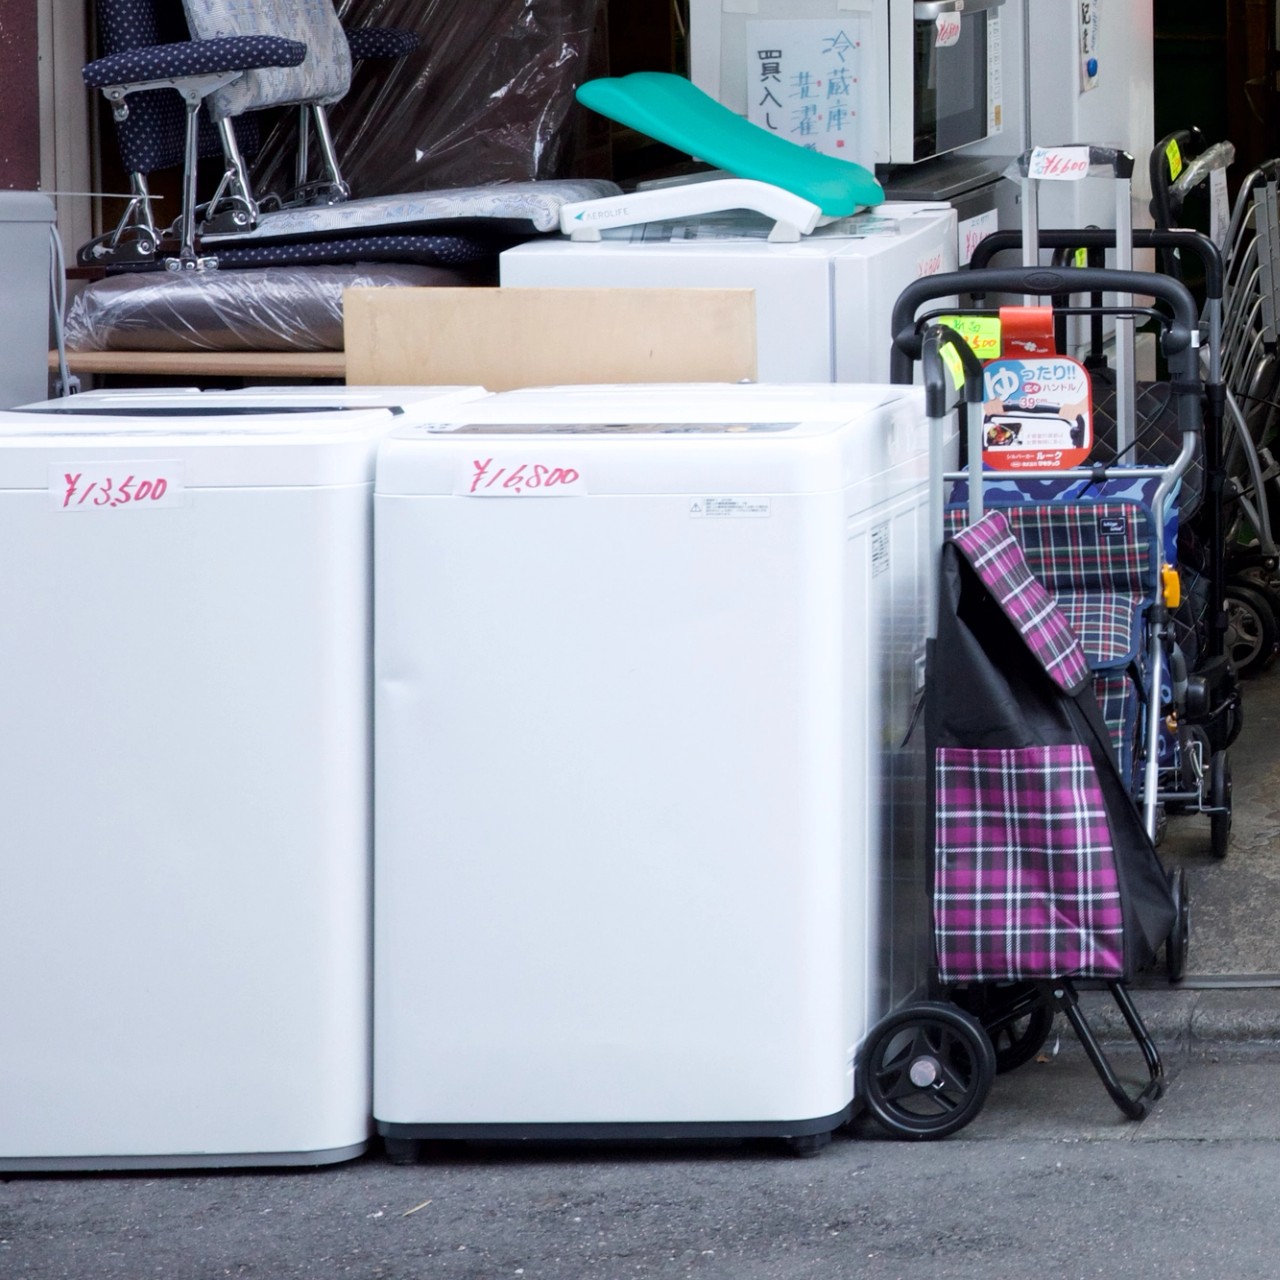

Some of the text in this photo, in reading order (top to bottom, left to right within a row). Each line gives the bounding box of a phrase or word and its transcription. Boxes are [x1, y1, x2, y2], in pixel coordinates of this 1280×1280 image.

[821, 29, 857, 133] 冷蔵庫
[1043, 382, 1076, 392] ハンドル
[63, 472, 168, 508] ¥13,500
[469, 457, 580, 494] ¥16,800
